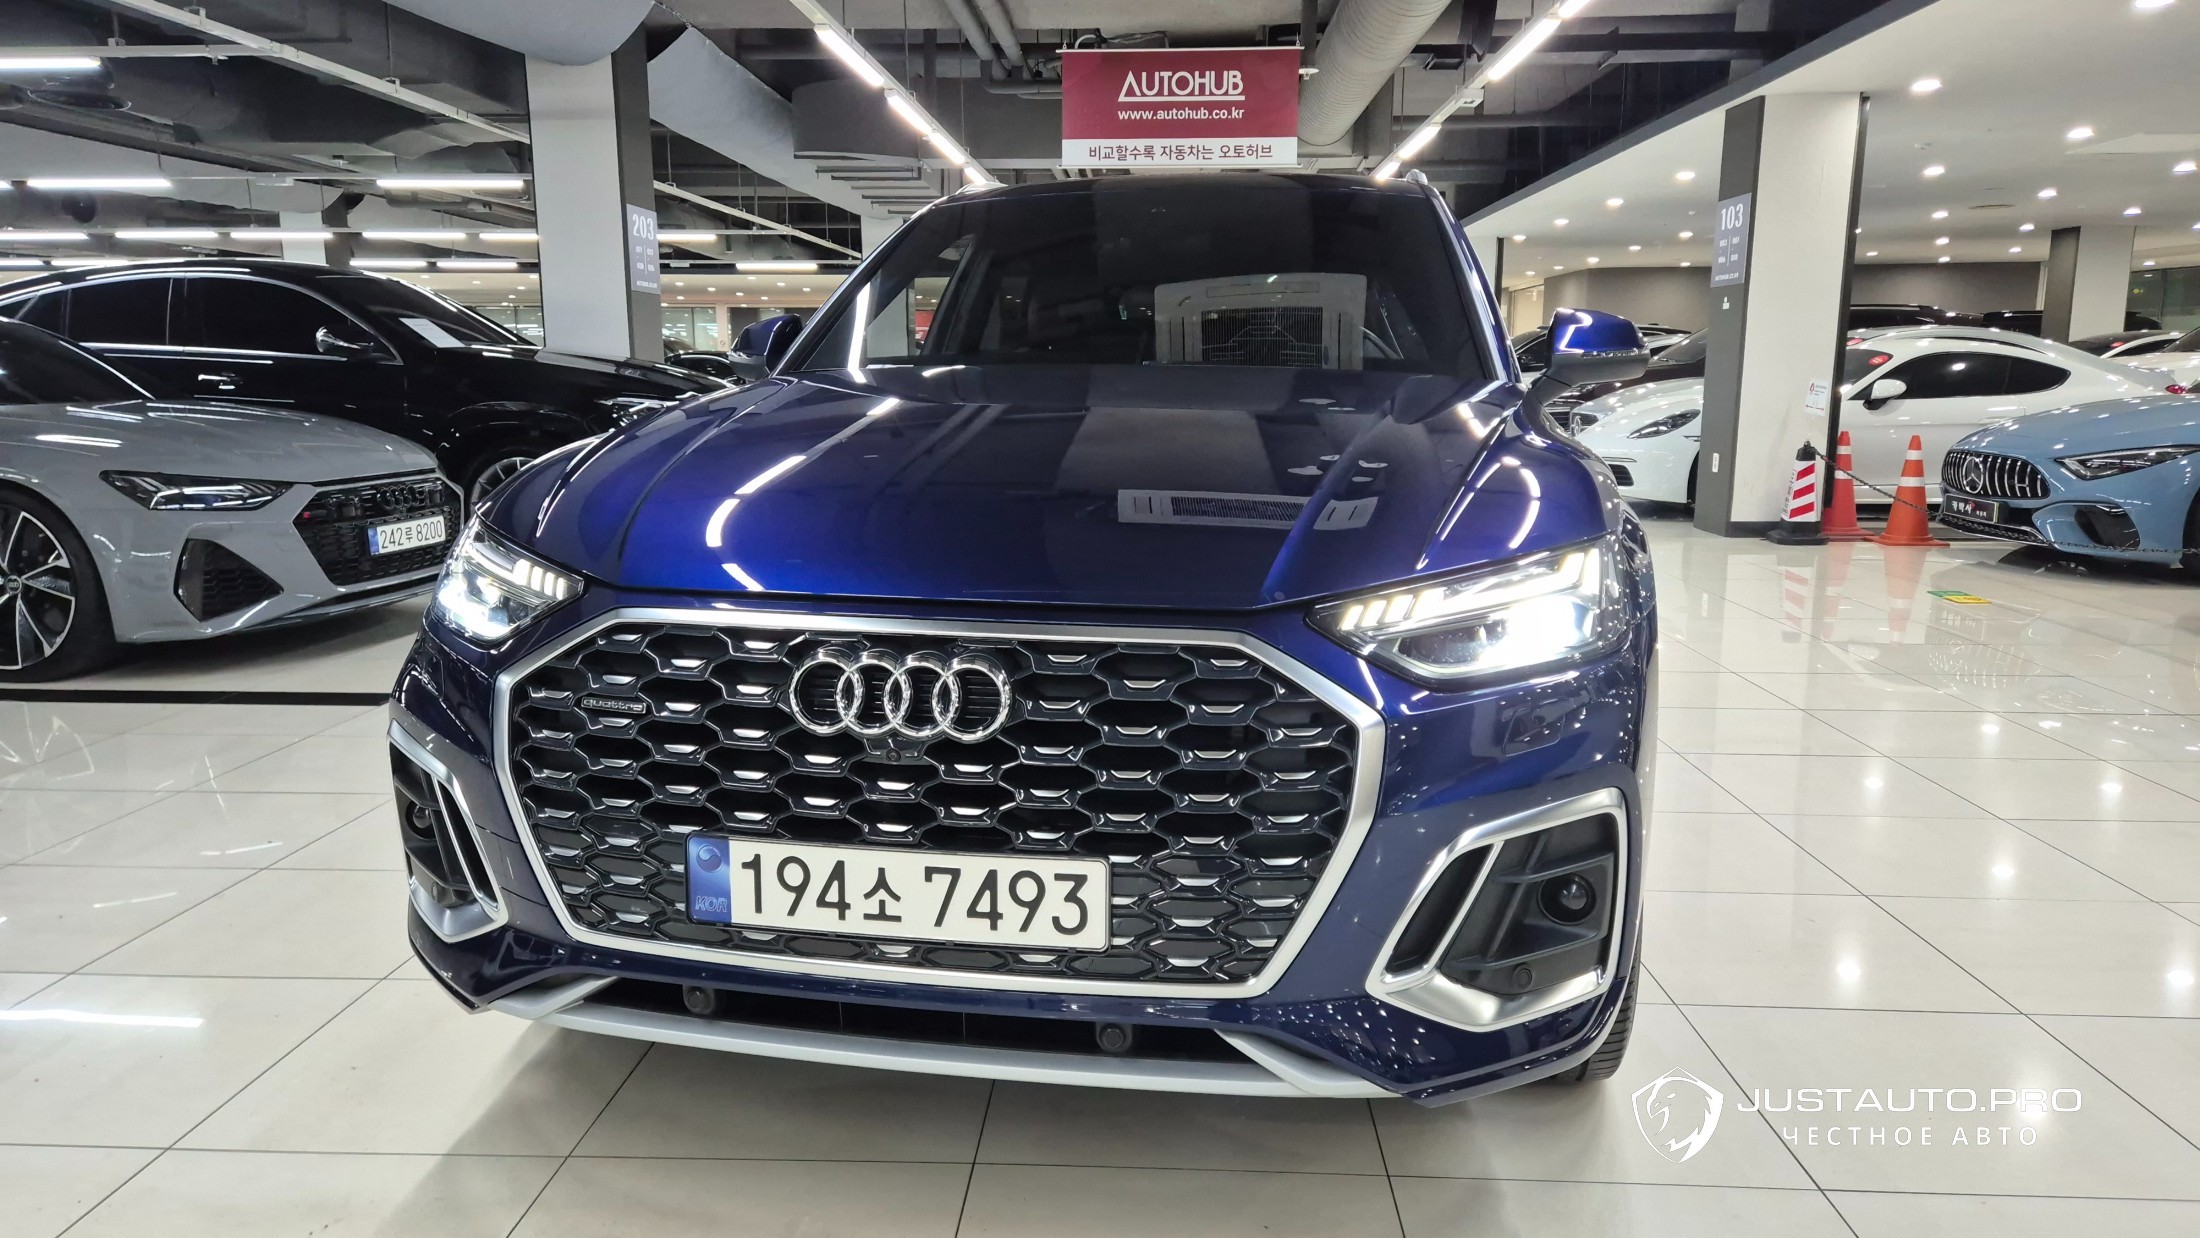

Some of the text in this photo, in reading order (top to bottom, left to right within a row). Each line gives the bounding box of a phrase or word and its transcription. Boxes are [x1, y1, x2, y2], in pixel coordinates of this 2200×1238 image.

[1118, 70, 1245, 101] AUTOHUB
[1118, 107, 1244, 120] www.autohub.co.kr
[1089, 144, 1273, 162] 비교할수록 자동차는 오토허브
[632, 213, 654, 240] 203
[1721, 203, 1744, 230] 103
[416, 520, 442, 542] 8200
[583, 699, 643, 711] quattro
[695, 896, 727, 913] KOR
[741, 853, 1088, 936] 194소 7493
